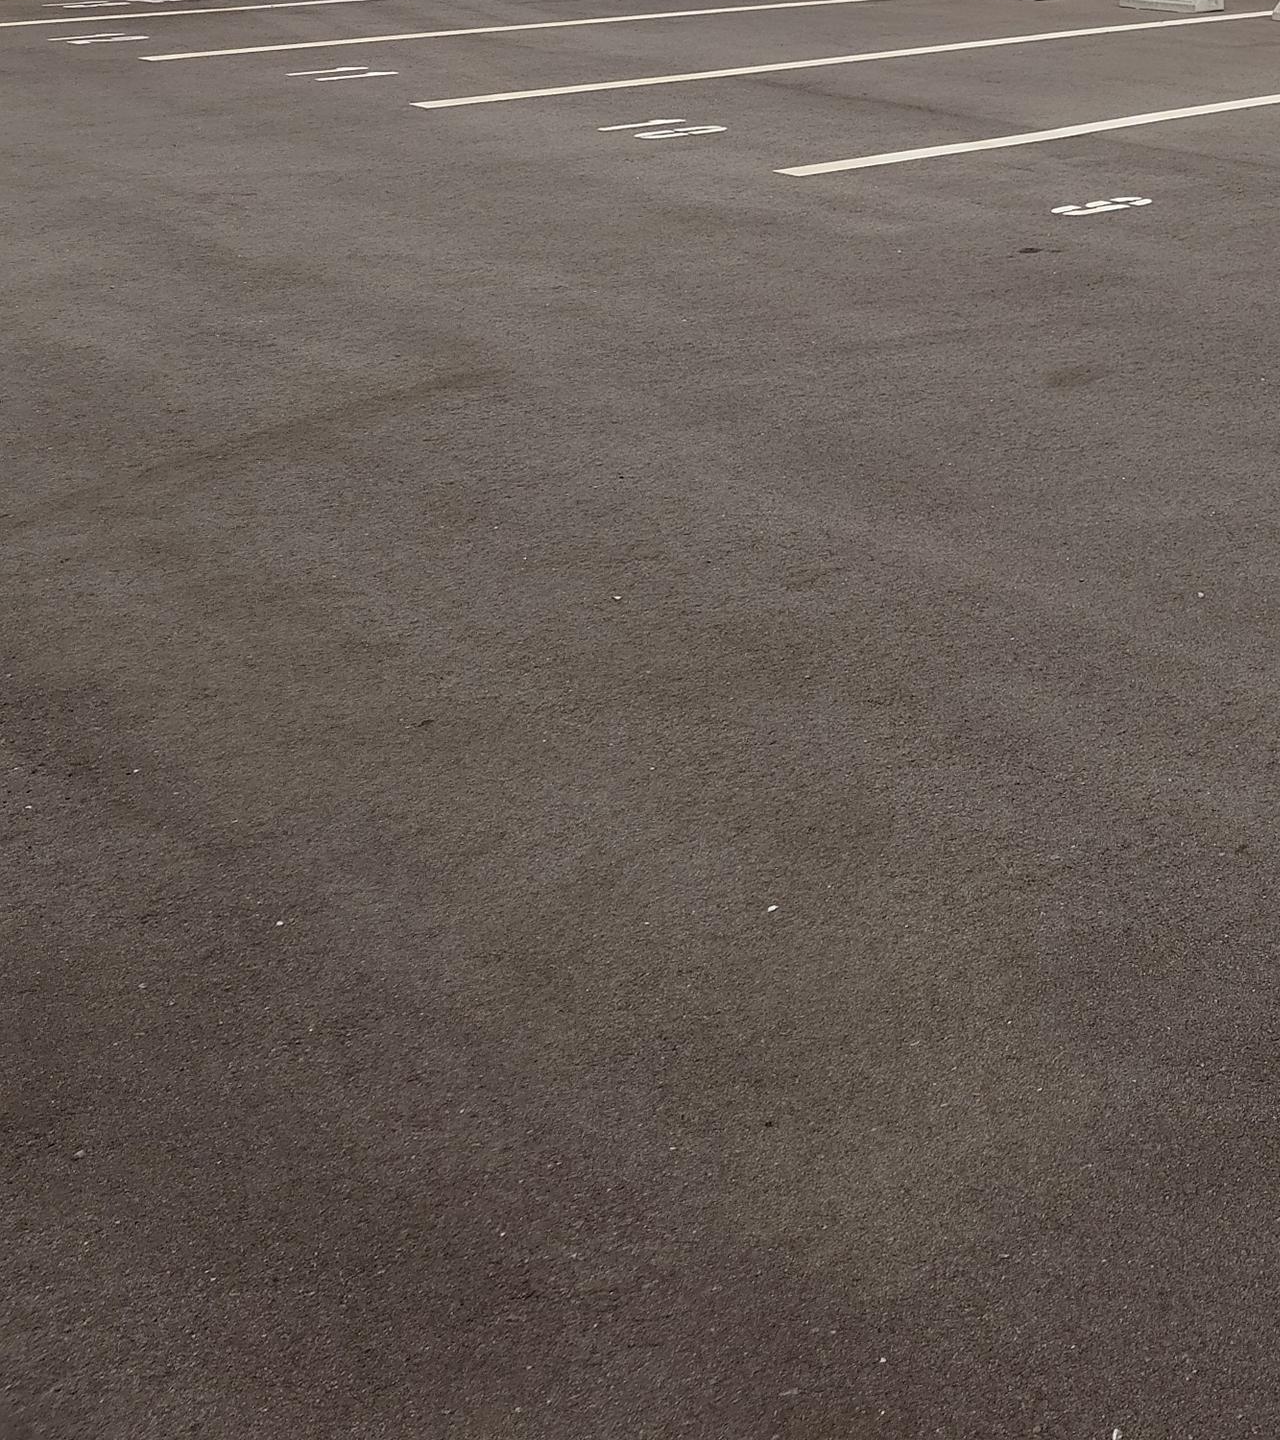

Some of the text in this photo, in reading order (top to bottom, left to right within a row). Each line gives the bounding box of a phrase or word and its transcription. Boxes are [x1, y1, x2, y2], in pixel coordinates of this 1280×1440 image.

[285, 66, 400, 82] 11
[597, 118, 728, 140] 10
[1050, 196, 1153, 216] 9
